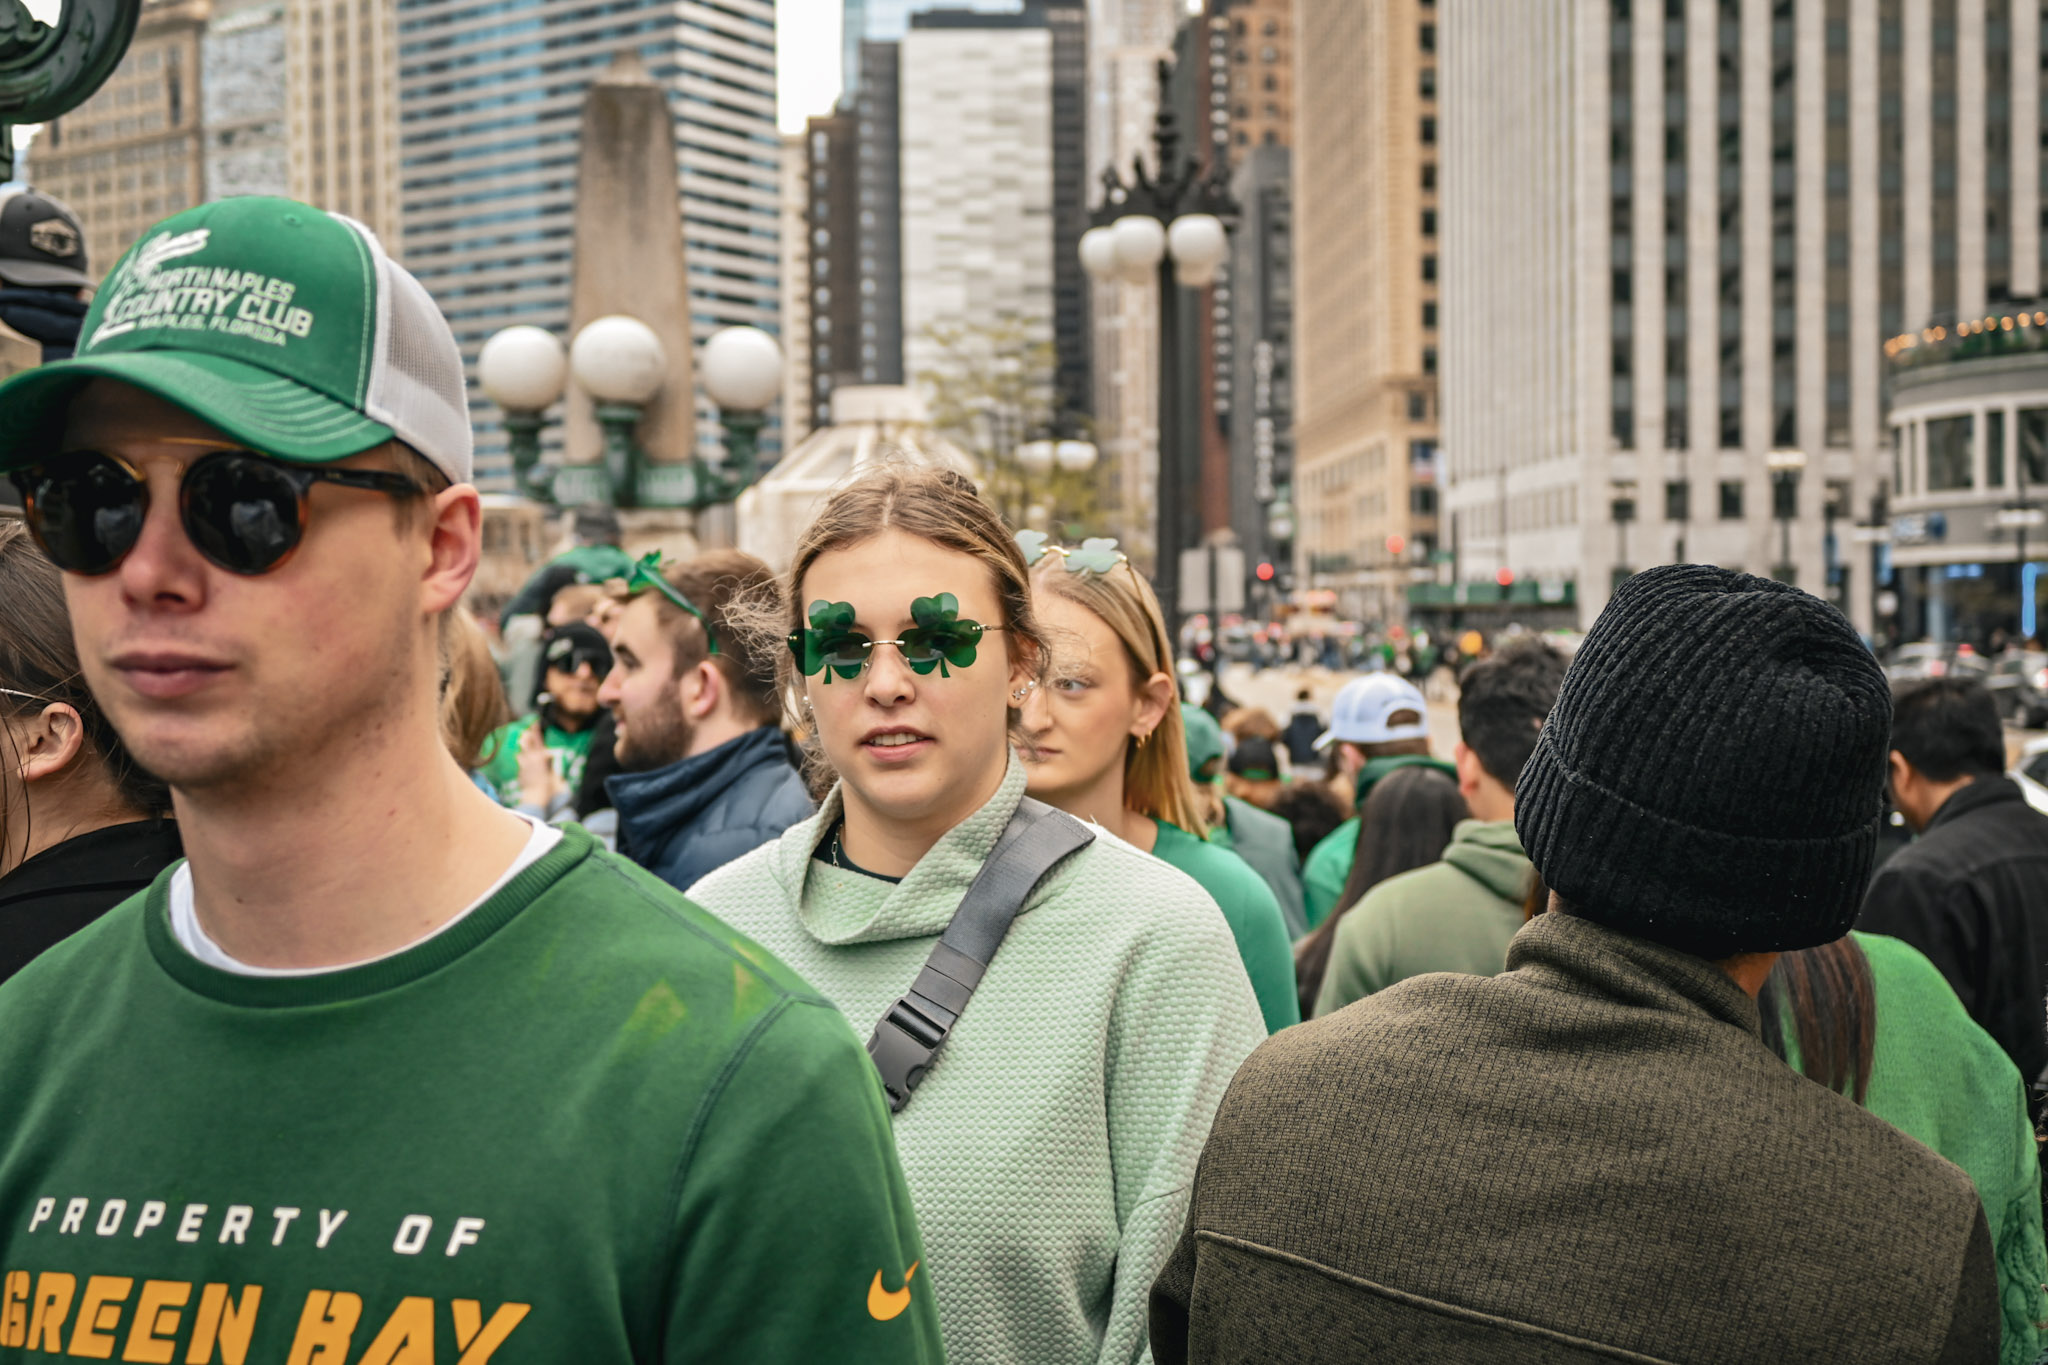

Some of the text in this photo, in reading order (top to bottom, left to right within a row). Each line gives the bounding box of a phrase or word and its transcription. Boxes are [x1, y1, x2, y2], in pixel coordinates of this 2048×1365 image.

[145, 266, 296, 304] NORTH NAPLES
[113, 286, 314, 338] COUNTRY CLUB
[209, 316, 287, 346] FLORIDA
[28, 1197, 486, 1257] PROPERTY OF
[0, 1270, 532, 1365] GREEN BAY
